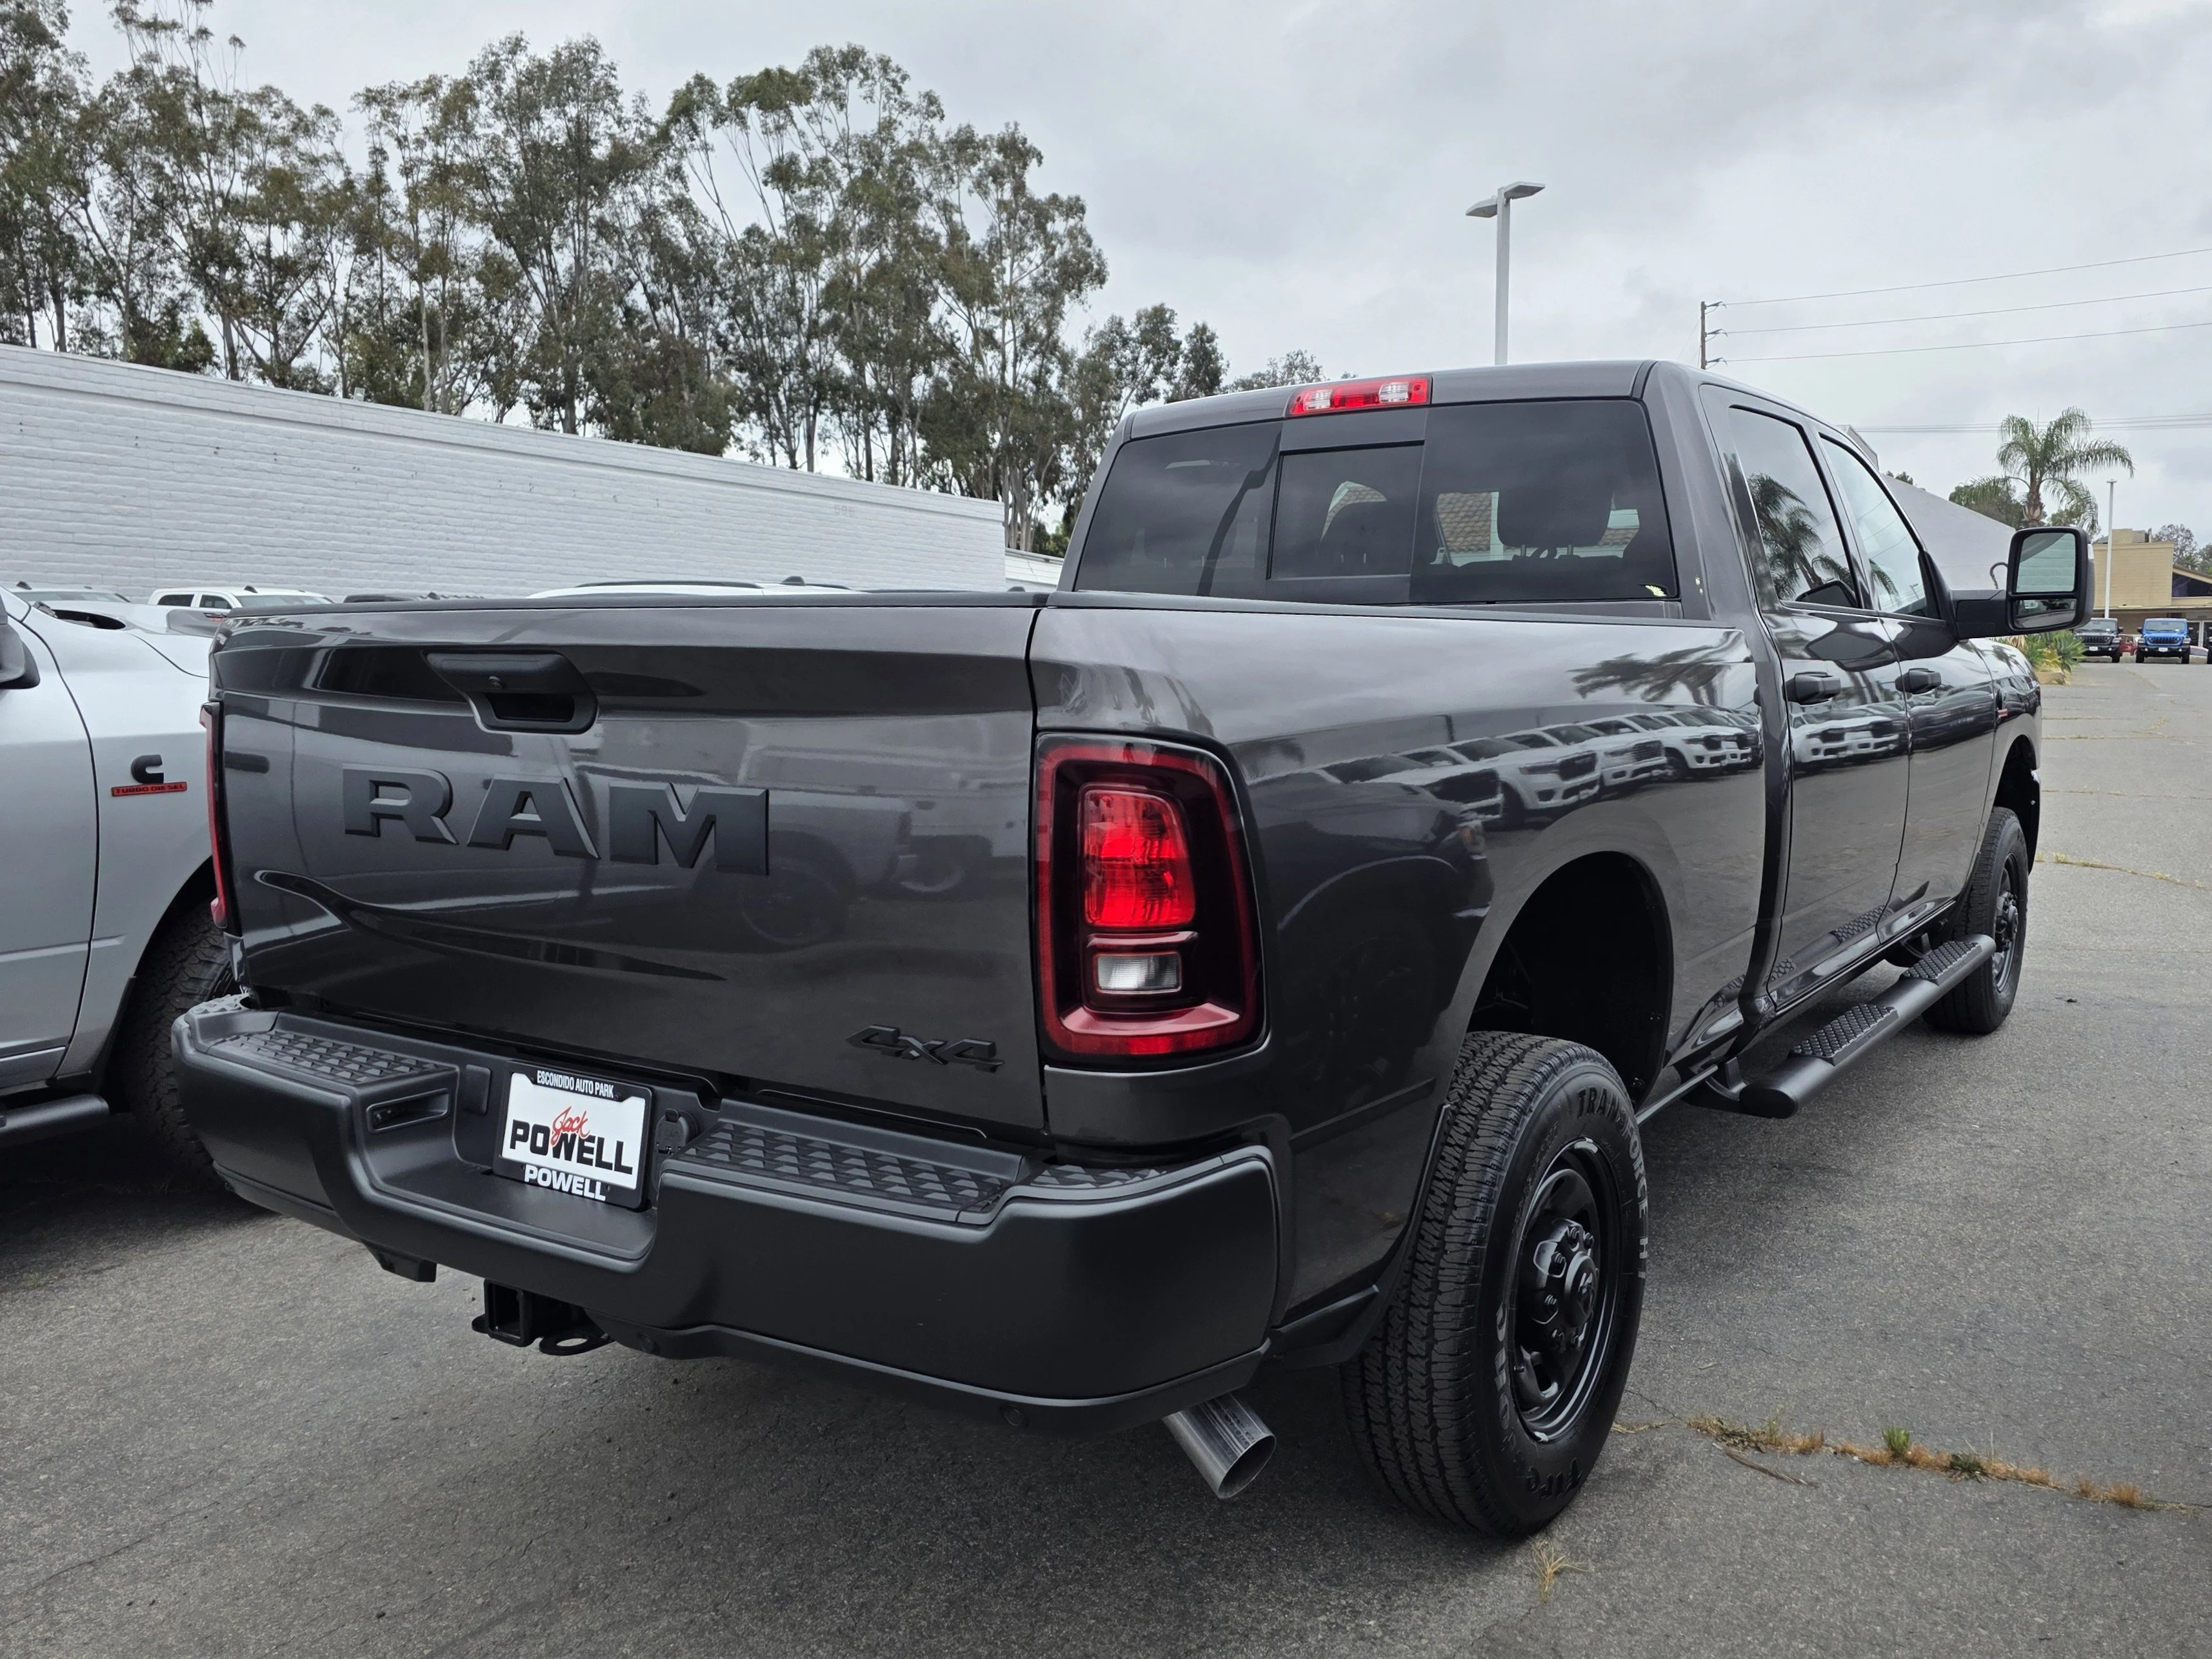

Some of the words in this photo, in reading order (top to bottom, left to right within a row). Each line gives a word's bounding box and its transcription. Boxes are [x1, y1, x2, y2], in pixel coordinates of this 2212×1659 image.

[342, 763, 769, 876] RAM
[537, 1070, 574, 1091] ESCONDIDO
[575, 1079, 593, 1094] AUTO
[595, 1081, 614, 1098] PARK
[550, 1106, 590, 1145] Jack
[510, 1119, 633, 1175] POWELL
[524, 1163, 606, 1202] POWELL
